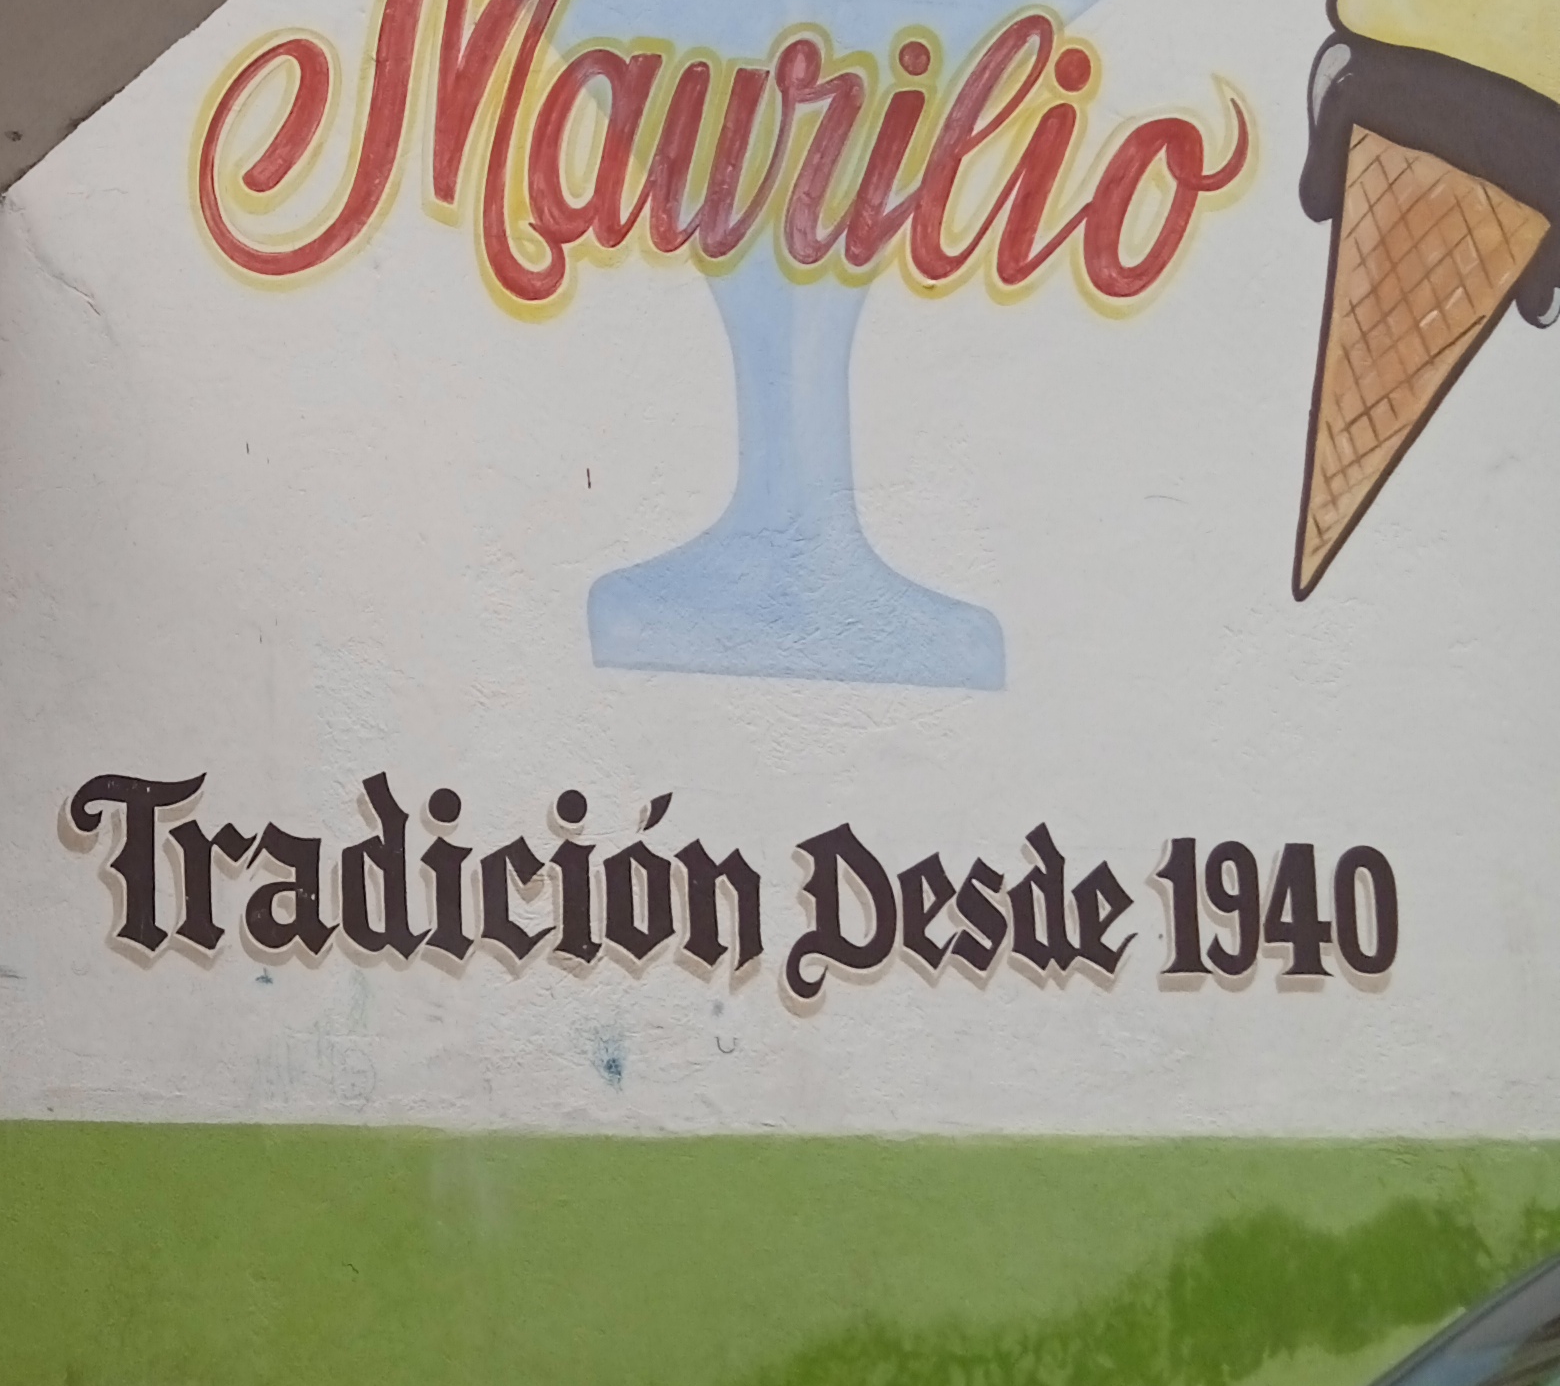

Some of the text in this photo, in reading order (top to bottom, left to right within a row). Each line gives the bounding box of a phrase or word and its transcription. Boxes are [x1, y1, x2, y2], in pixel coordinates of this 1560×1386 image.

[69, 770, 1399, 999] Tradición Desde 1940
